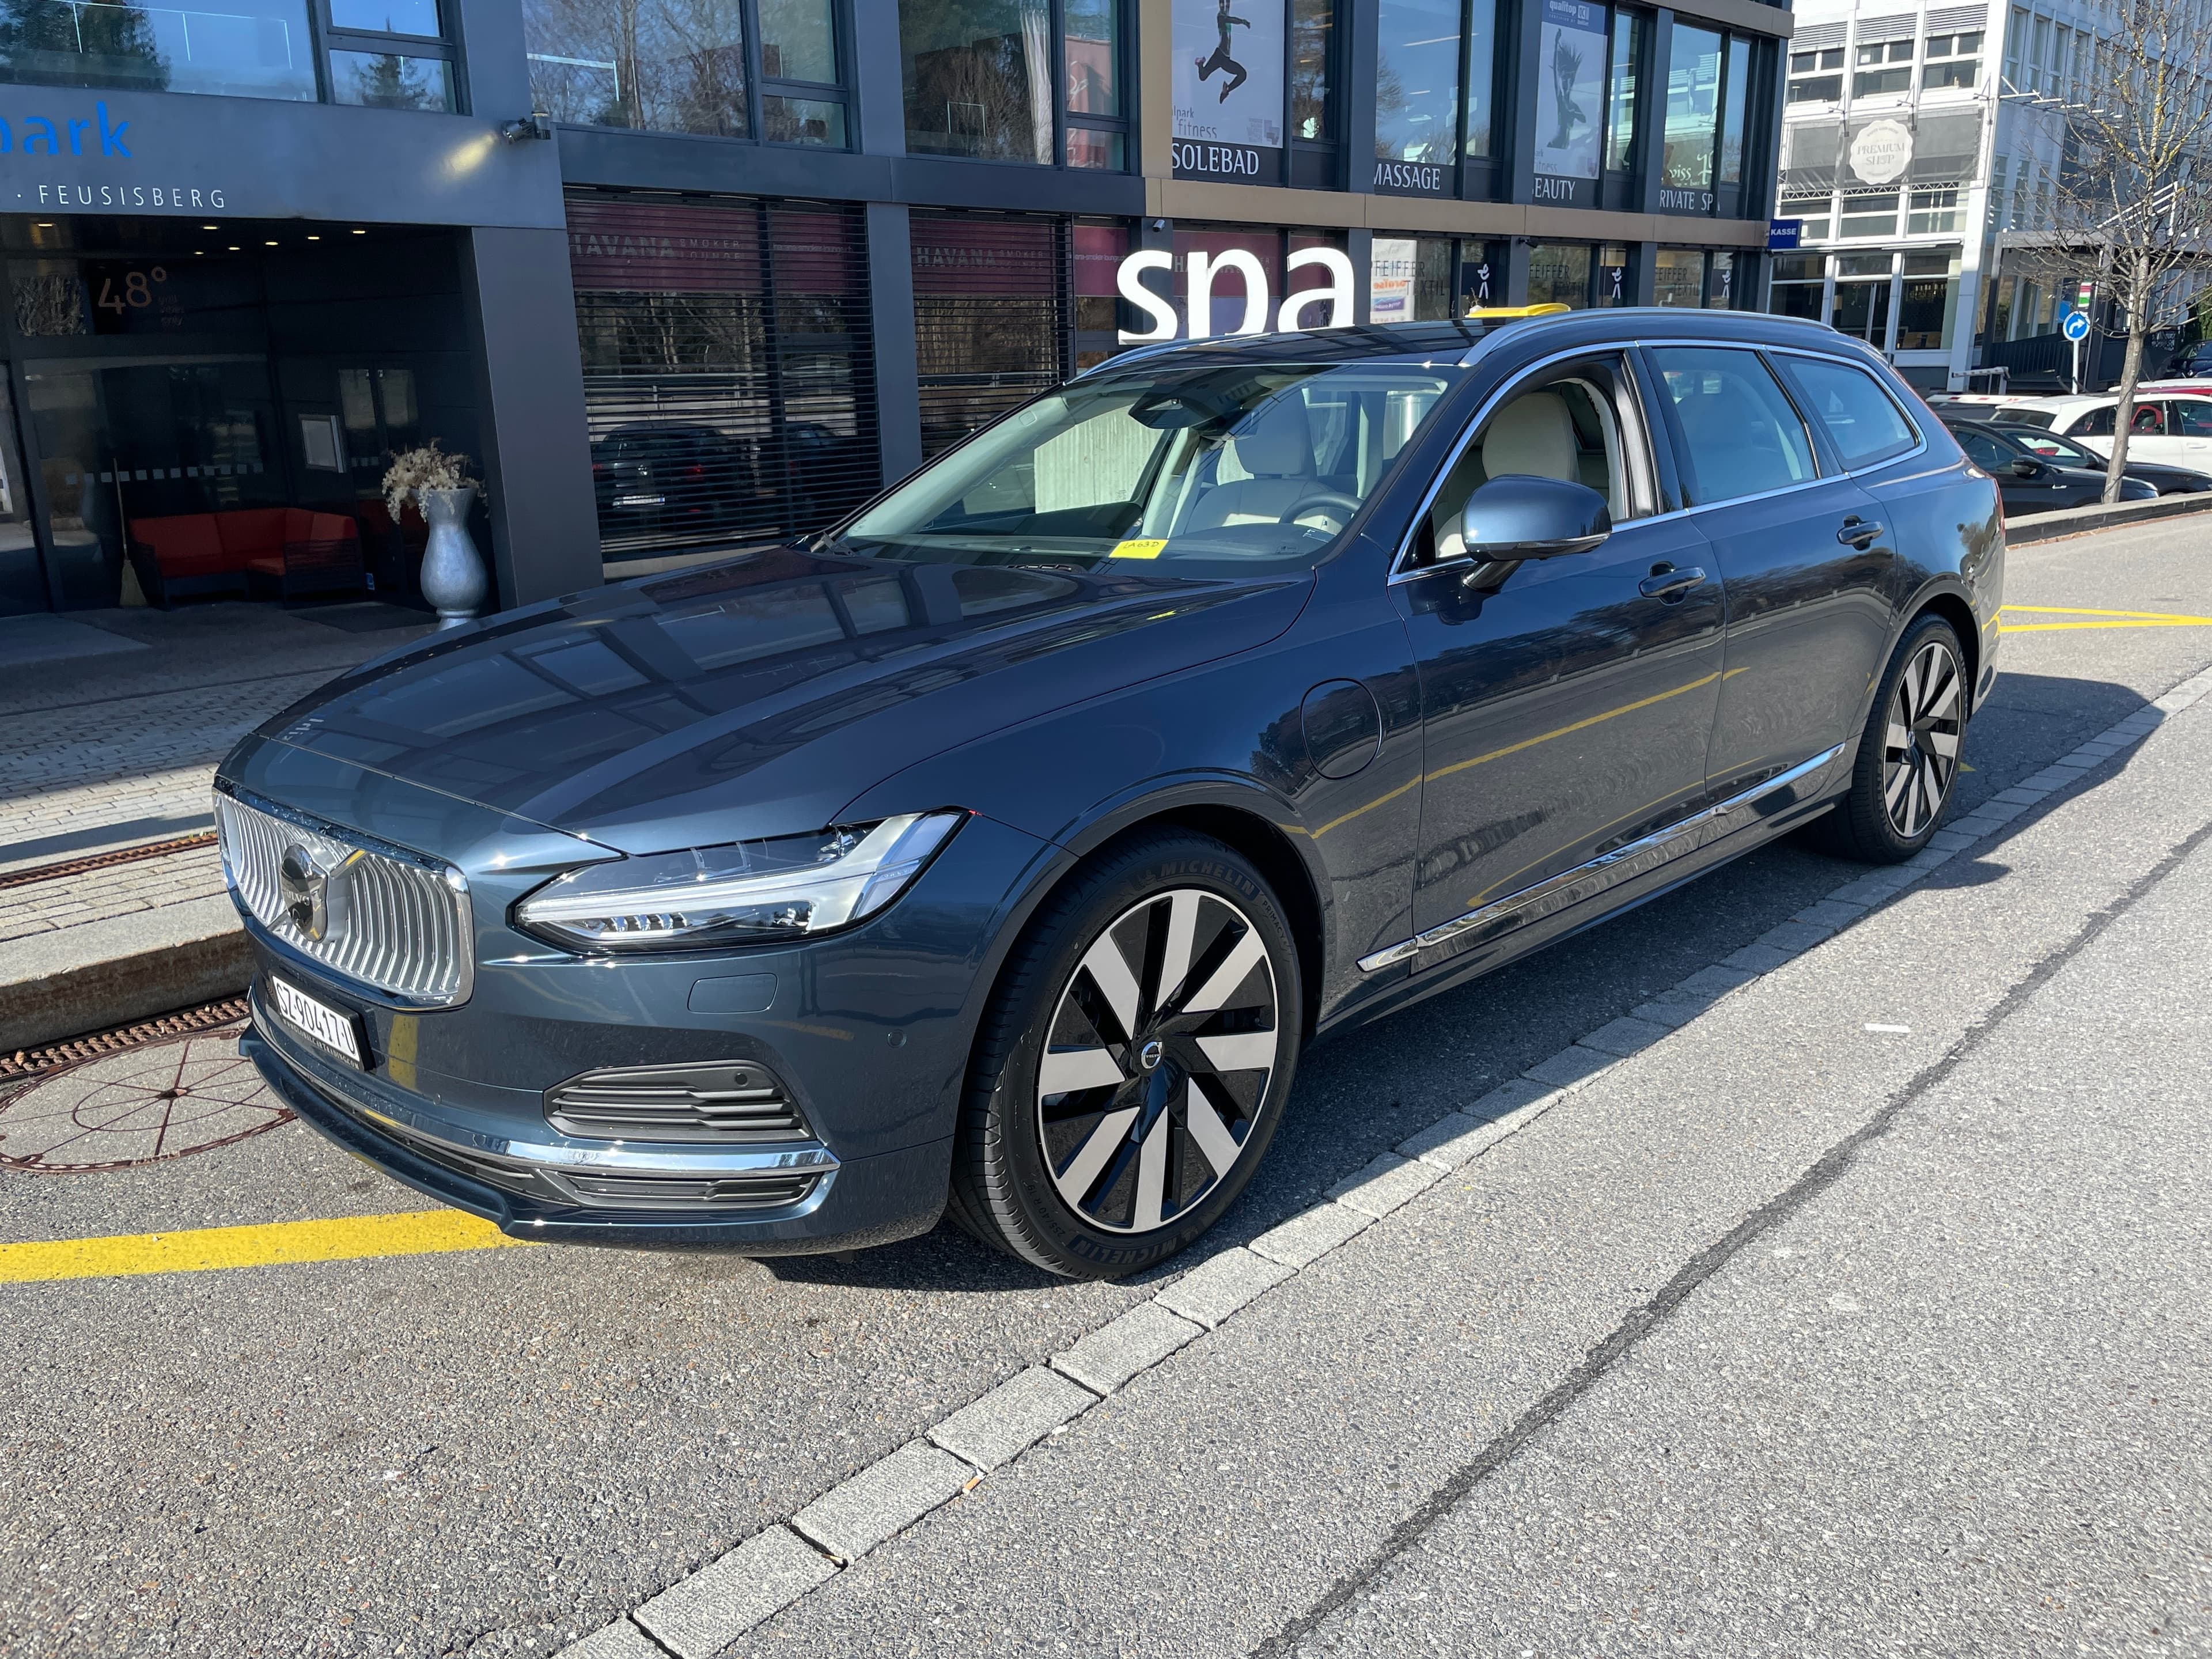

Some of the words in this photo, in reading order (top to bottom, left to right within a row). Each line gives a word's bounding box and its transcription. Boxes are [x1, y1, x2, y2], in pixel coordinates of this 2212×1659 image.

[1550, 1, 1577, 16] qualitop
[1172, 105, 1194, 120] lpark
[1178, 119, 1217, 139] fitness
[1172, 142, 1259, 175] SOLEBAD
[1857, 142, 1904, 155] PREMIUM
[1866, 154, 1895, 166] SHOP
[39, 185, 226, 209] FEUSISBERG
[1532, 177, 1575, 200] EAUTY
[1660, 190, 1695, 210] RIVATE
[1701, 193, 1720, 211] SP
[1771, 228, 1797, 236] KASSE
[916, 246, 997, 267] HAVANA
[1373, 260, 1425, 277] FEIFFER
[1118, 247, 1355, 344] spa
[1161, 859, 1256, 895] MICHELIN
[1263, 900, 1287, 938] PRIMACY
[1073, 1237, 1177, 1263] MICHELIN
